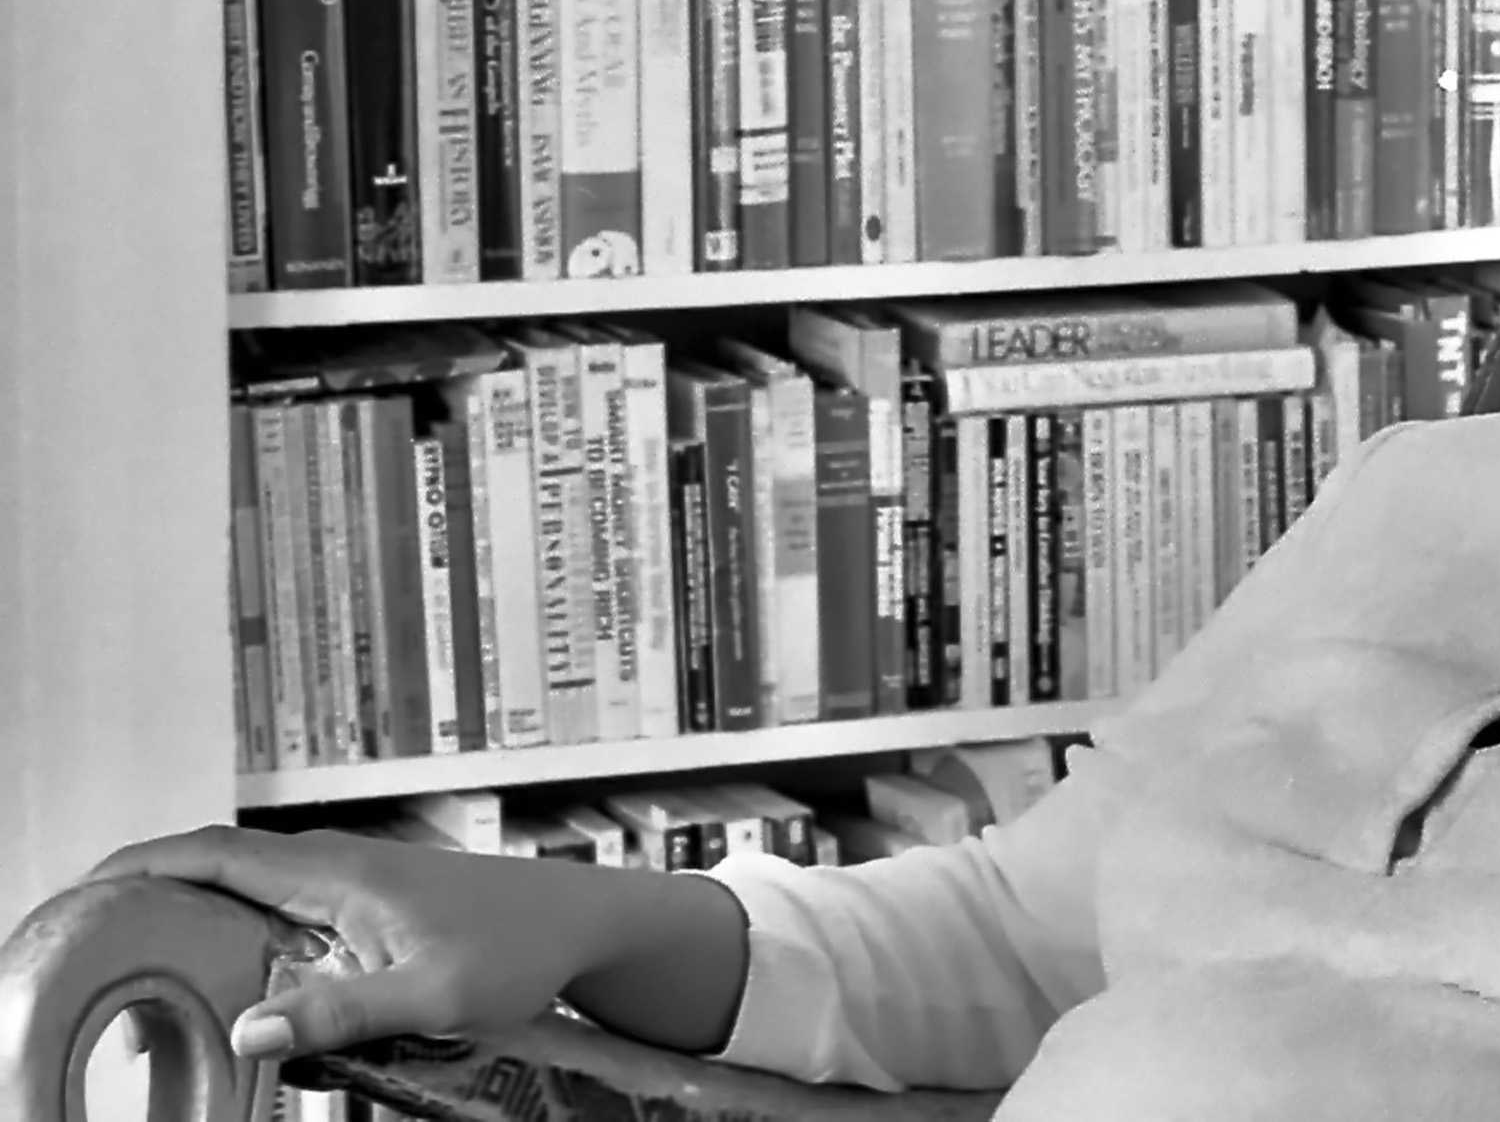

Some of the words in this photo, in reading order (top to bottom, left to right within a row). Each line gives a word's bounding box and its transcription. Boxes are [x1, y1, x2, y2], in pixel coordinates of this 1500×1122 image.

[235, 152, 253, 196] THEY
[439, 107, 473, 227] HISTORY
[236, 199, 256, 253] LIVED
[1436, 309, 1468, 387] TNT
[586, 436, 607, 464] TO
[606, 388, 629, 464] SMART
[588, 468, 610, 584] BECOMING
[538, 483, 572, 673] PERSONALITY
[594, 589, 615, 642] RICH
